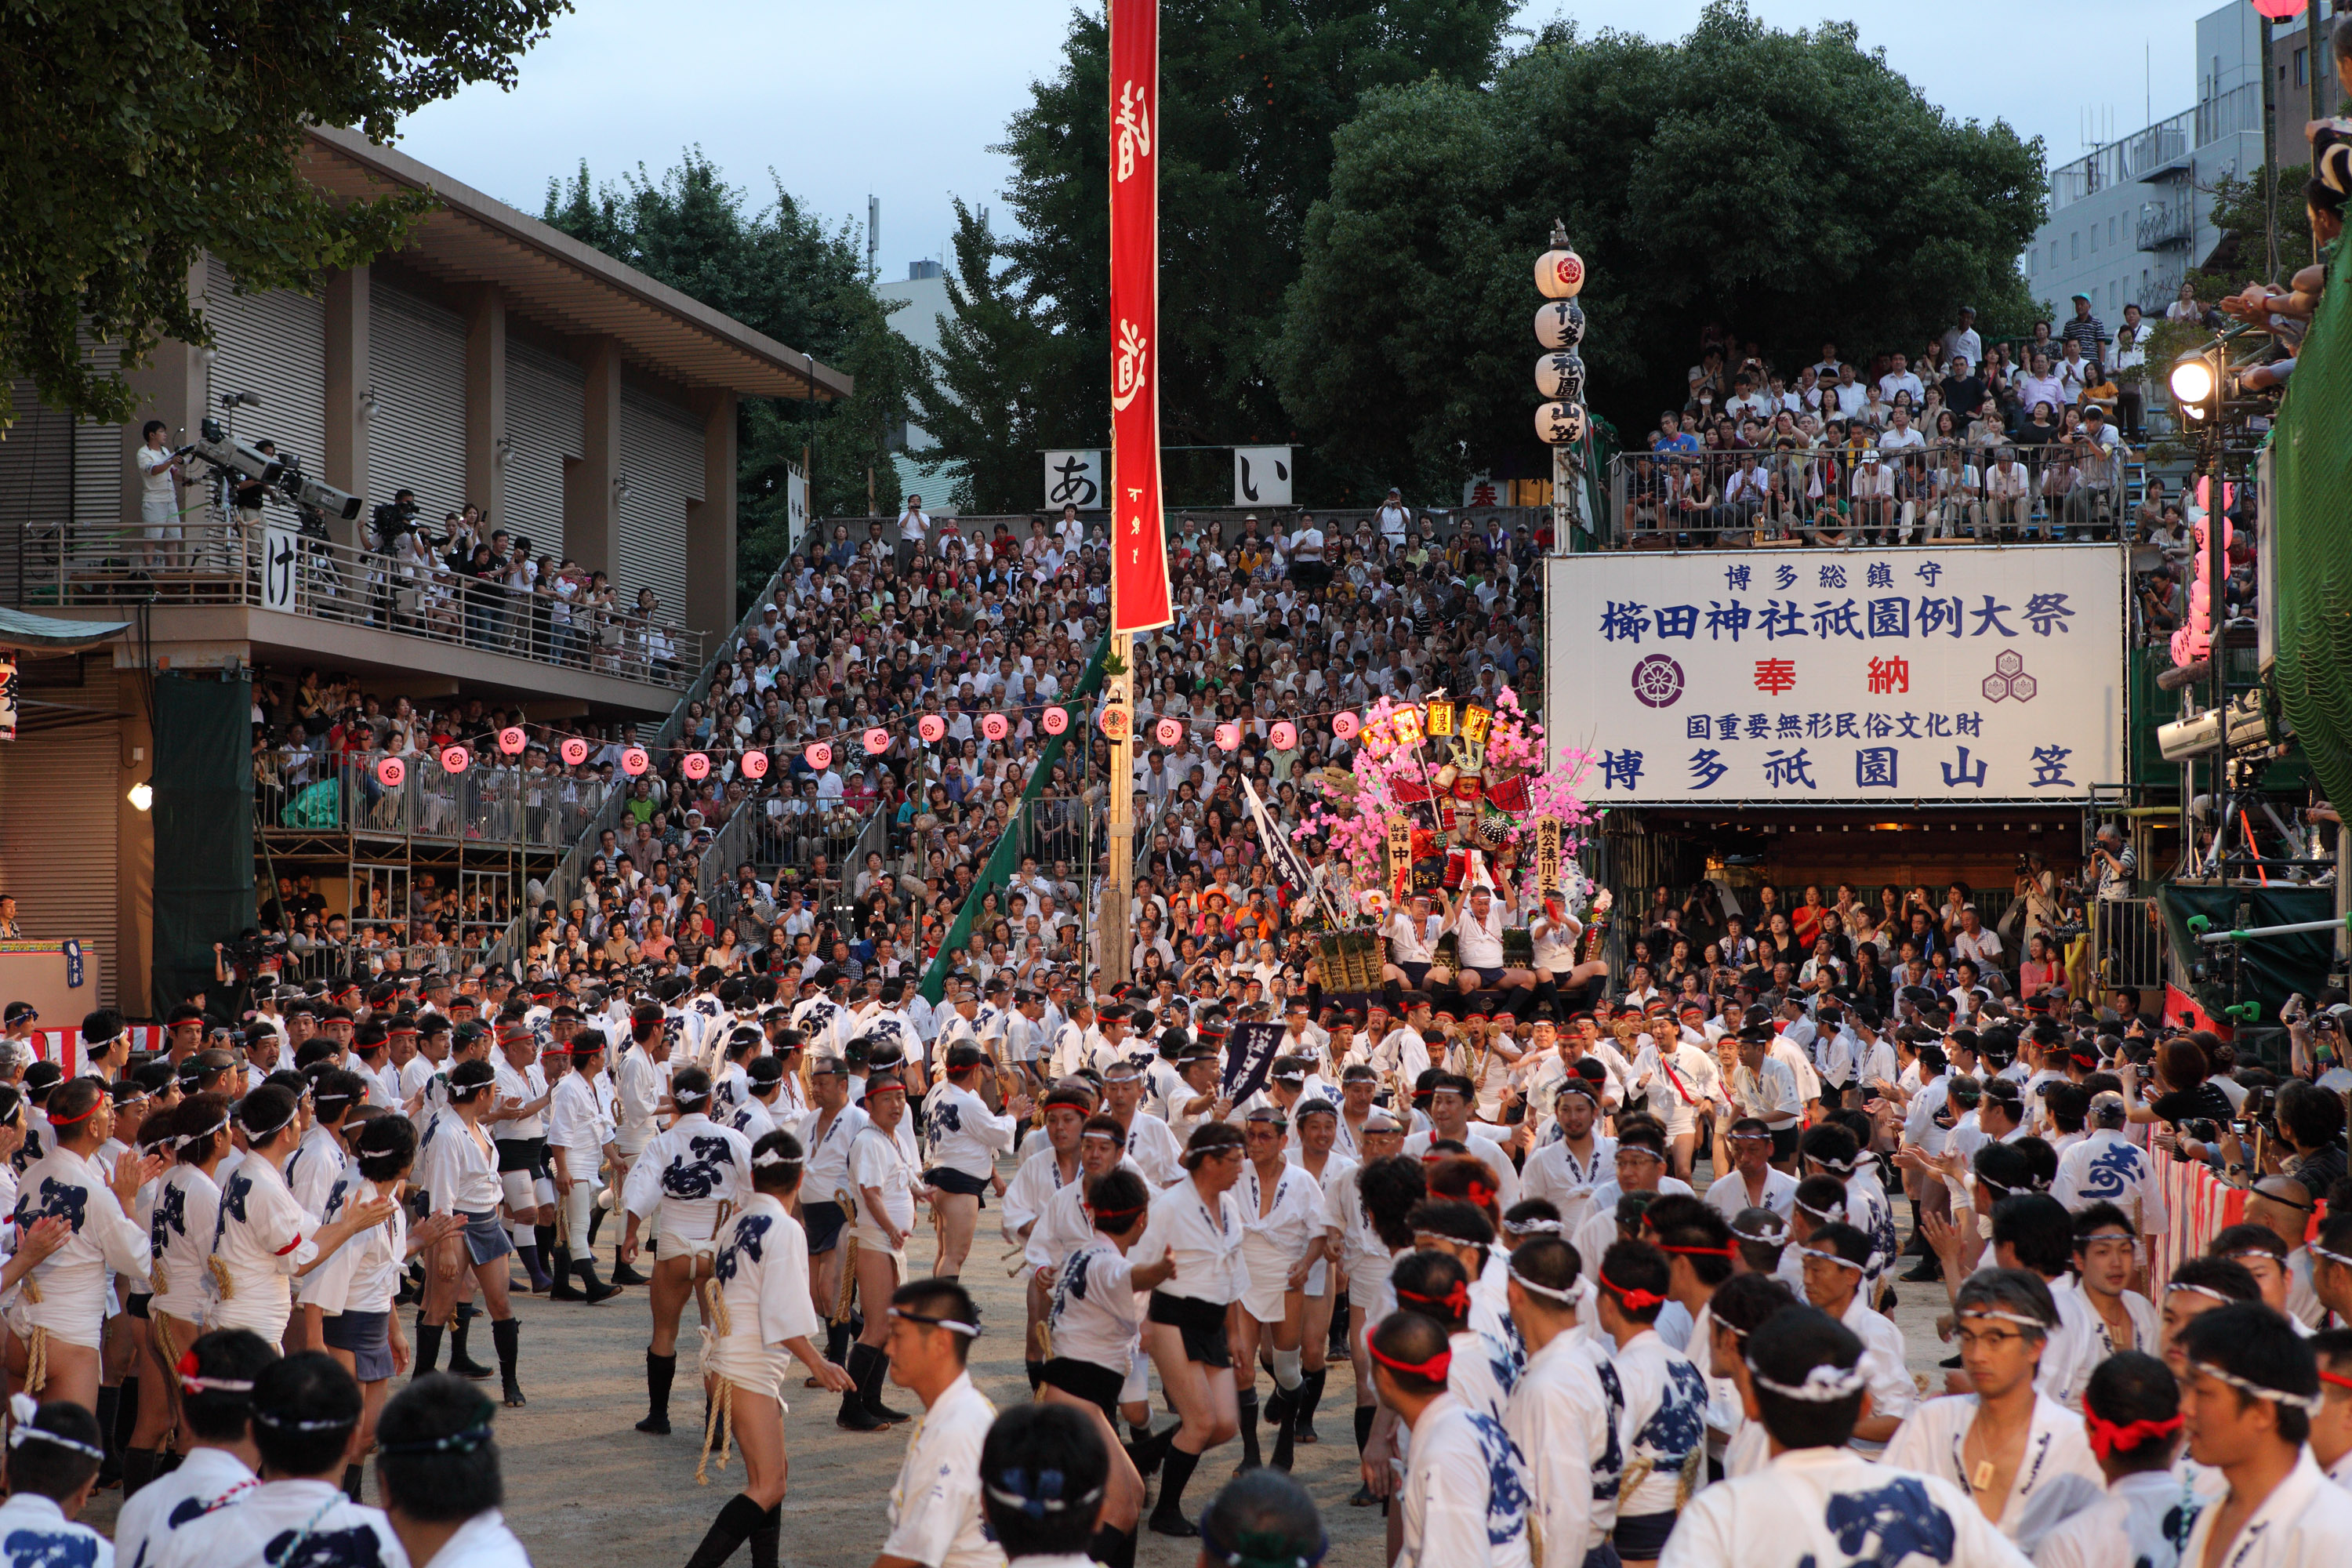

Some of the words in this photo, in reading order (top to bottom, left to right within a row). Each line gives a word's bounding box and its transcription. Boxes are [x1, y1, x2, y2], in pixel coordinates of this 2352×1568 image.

[1050, 455, 1098, 506] あ
[1240, 455, 1288, 502] い
[268, 535, 294, 606] け
[1724, 560, 1943, 591] 博多総鎮守
[1599, 592, 2076, 644] 櫛田神社祇園例大祭
[1754, 655, 1910, 696] 奉納
[1108, 712, 1120, 726] 東
[1686, 711, 1984, 741] 国重要無形民俗文化財
[1597, 744, 2076, 791] 博多祇園山笠
[1390, 823, 1399, 842] 山笠
[1399, 823, 1409, 842] 七番
[1540, 820, 1557, 915] 楠公湊川之
